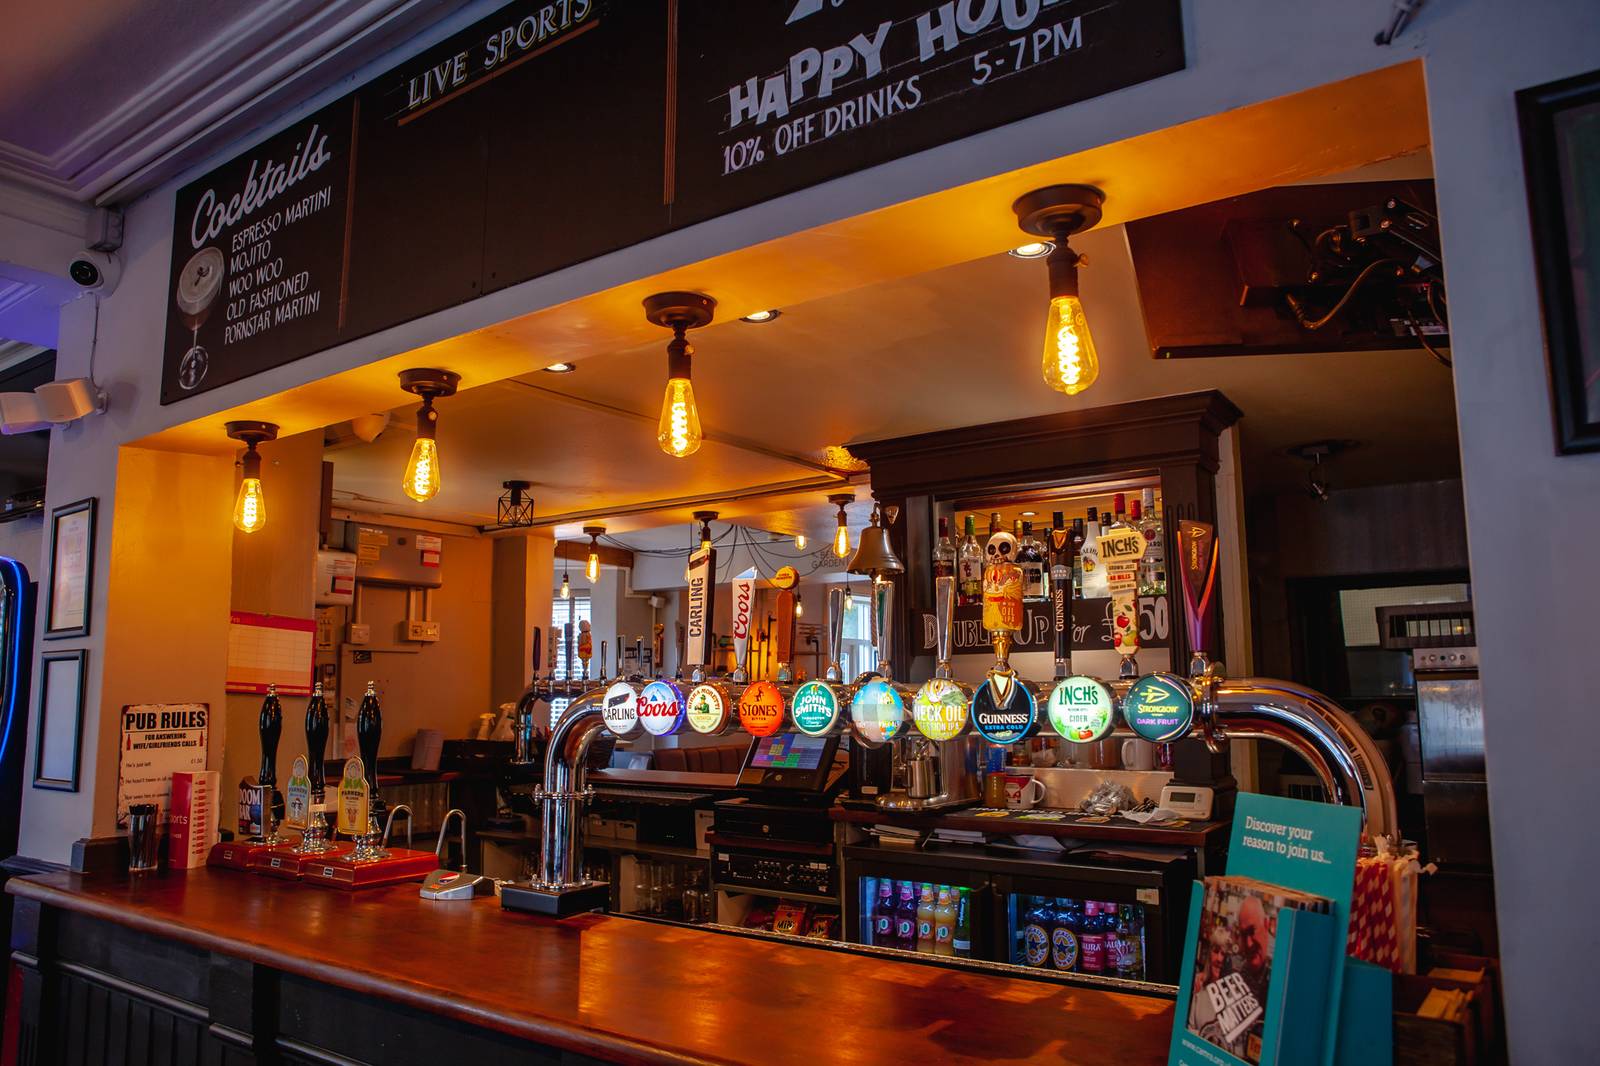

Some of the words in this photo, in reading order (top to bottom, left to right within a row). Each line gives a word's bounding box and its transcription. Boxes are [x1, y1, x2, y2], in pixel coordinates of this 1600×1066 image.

[407, 50, 468, 110] LIVE
[483, 0, 592, 70] SPORTS
[728, 20, 893, 128] HAPPY
[916, 0, 1056, 63] HOU
[723, 136, 765, 176] 10%
[775, 113, 816, 156] OFF
[824, 75, 923, 138] DRINKS
[191, 124, 331, 249] Cocktails
[232, 212, 282, 253] ESPRESSO
[285, 186, 331, 226] MARTINI
[230, 239, 271, 276] MOJITO
[229, 273, 253, 298] WOO
[256, 257, 283, 285] WOO
[226, 302, 246, 322] OLD
[250, 271, 310, 312] FASHIONED
[224, 312, 271, 345] PORNSTAR
[275, 290, 321, 325] MARTINI
[1101, 536, 1139, 558] INCH'S
[689, 577, 704, 638] CARLING
[734, 581, 752, 641] Coors
[1055, 588, 1065, 632] GUINNESS
[603, 708, 636, 720] CARLING
[636, 696, 679, 717] Coors
[741, 702, 778, 717] STONES
[800, 695, 826, 706] JOHN
[946, 705, 965, 721] OIL
[1059, 686, 1099, 705] INCH'S
[1137, 704, 1179, 714] STRONGBOW
[125, 712, 157, 731] PUB
[160, 710, 207, 729] RULES
[978, 713, 1029, 725] GUINNESS
[1245, 816, 1286, 836] Discover
[1287, 825, 1314, 841] your
[1243, 835, 1274, 852] reason
[1276, 841, 1287, 854] to
[1286, 841, 1309, 860] join
[1206, 972, 1251, 1014] BEER
